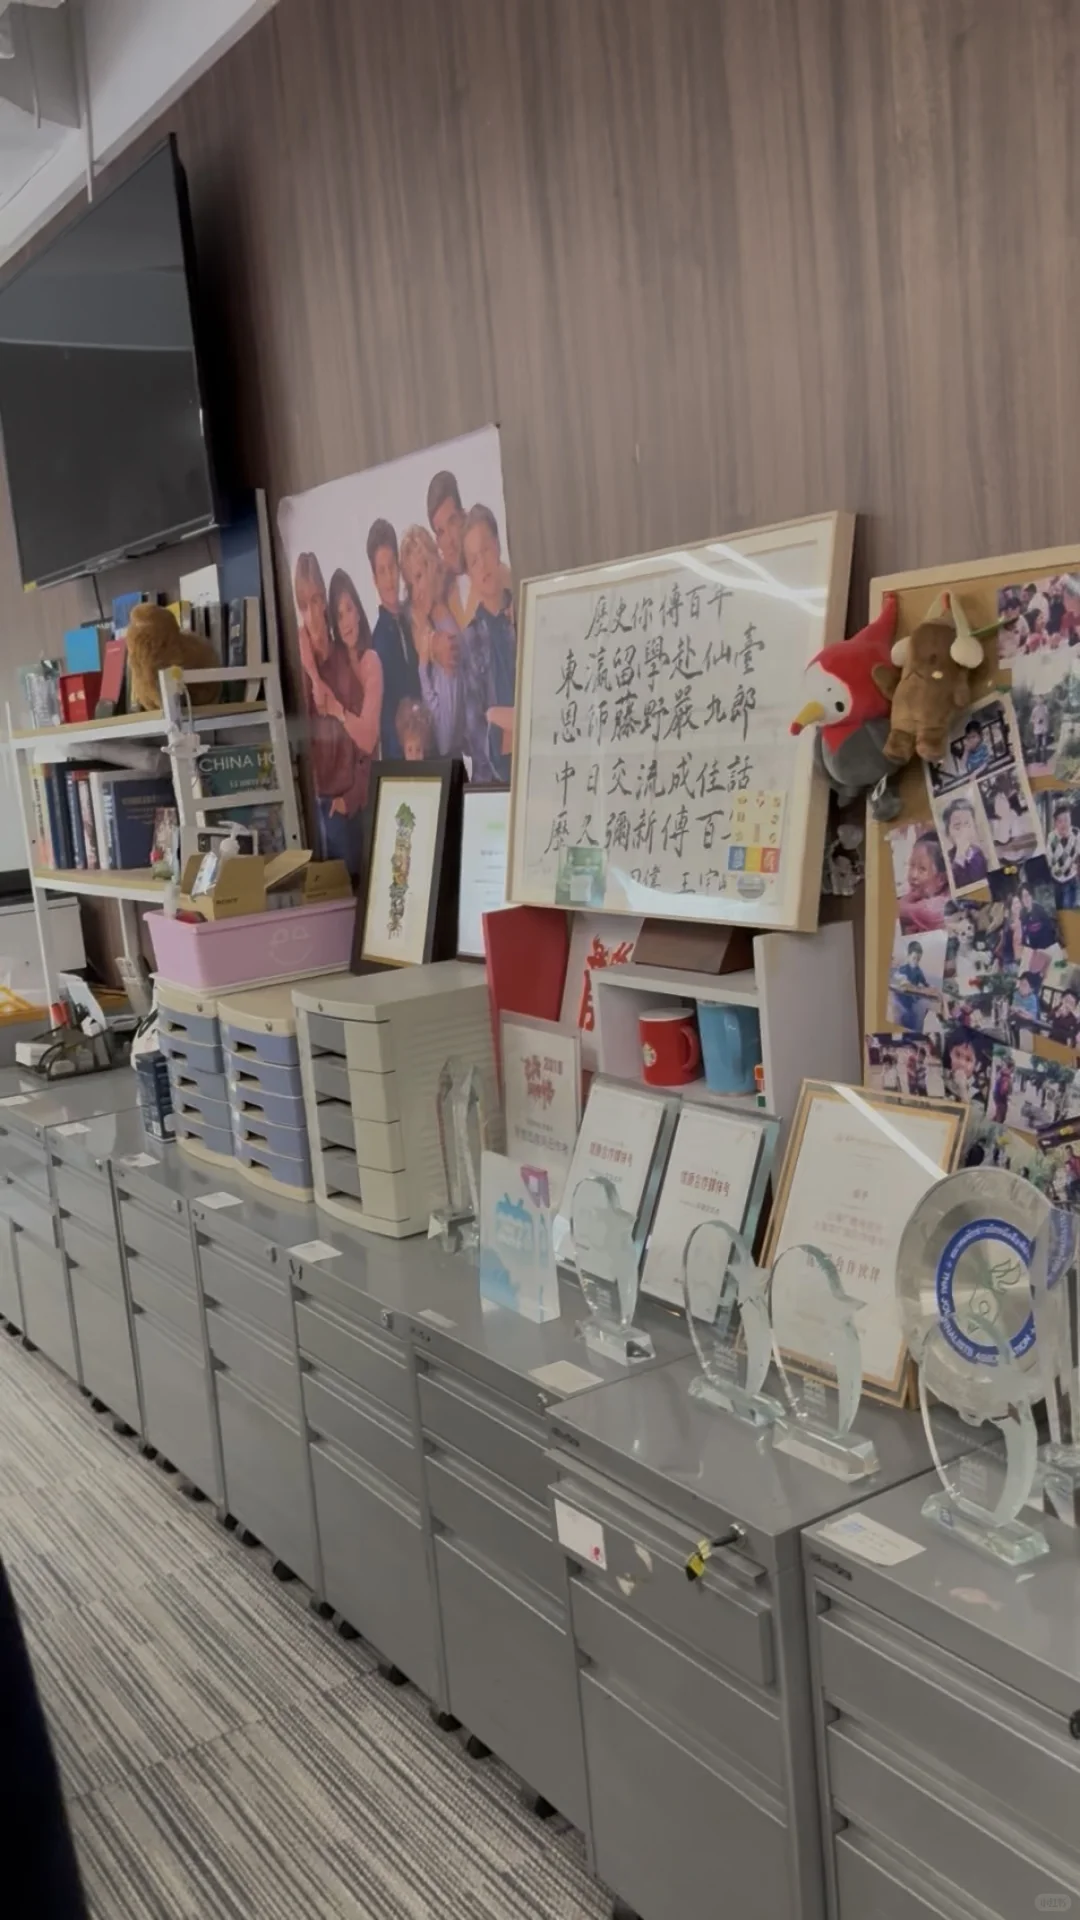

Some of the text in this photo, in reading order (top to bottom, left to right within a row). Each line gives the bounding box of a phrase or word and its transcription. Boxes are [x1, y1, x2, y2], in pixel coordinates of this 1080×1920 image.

[199, 754, 254, 773] CHINA
[543, 804, 734, 860] 歷久彌新傳百
[939, 1272, 951, 1298] THAI
